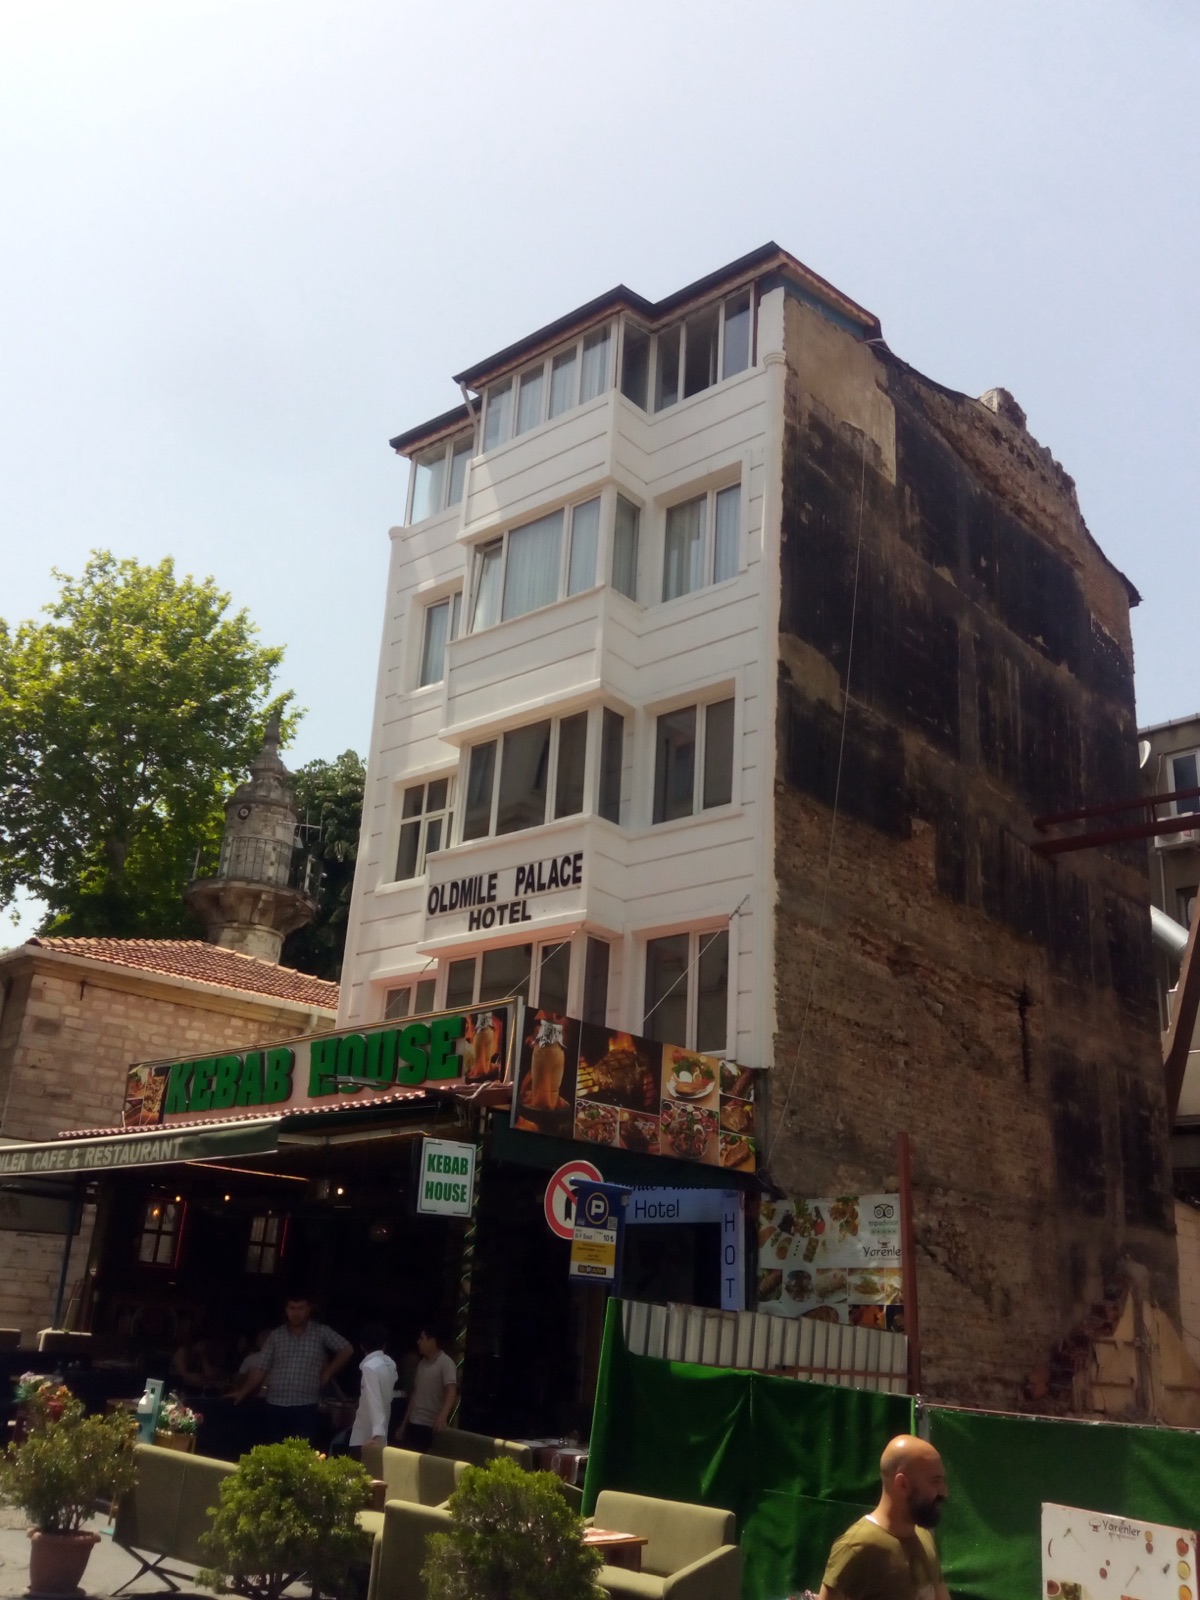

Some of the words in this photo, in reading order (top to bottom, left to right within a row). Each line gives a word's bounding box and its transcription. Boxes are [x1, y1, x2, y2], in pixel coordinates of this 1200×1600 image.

[428, 873, 498, 915] OLDMILE
[515, 853, 583, 896] PALACE
[468, 900, 531, 931] HOTEL
[164, 1047, 295, 1114] KEBAB
[308, 1016, 466, 1098] HOUSE
[32, 1149, 66, 1170] CAFE
[69, 1148, 79, 1168] &
[84, 1137, 183, 1166] RESTAURANT
[427, 1153, 469, 1175] KEBAB
[425, 1181, 467, 1203] HOUSE
[634, 1199, 680, 1218] Hotel
[862, 1246, 901, 1257] Yarenle
[1102, 1520, 1141, 1537] Yarenler
